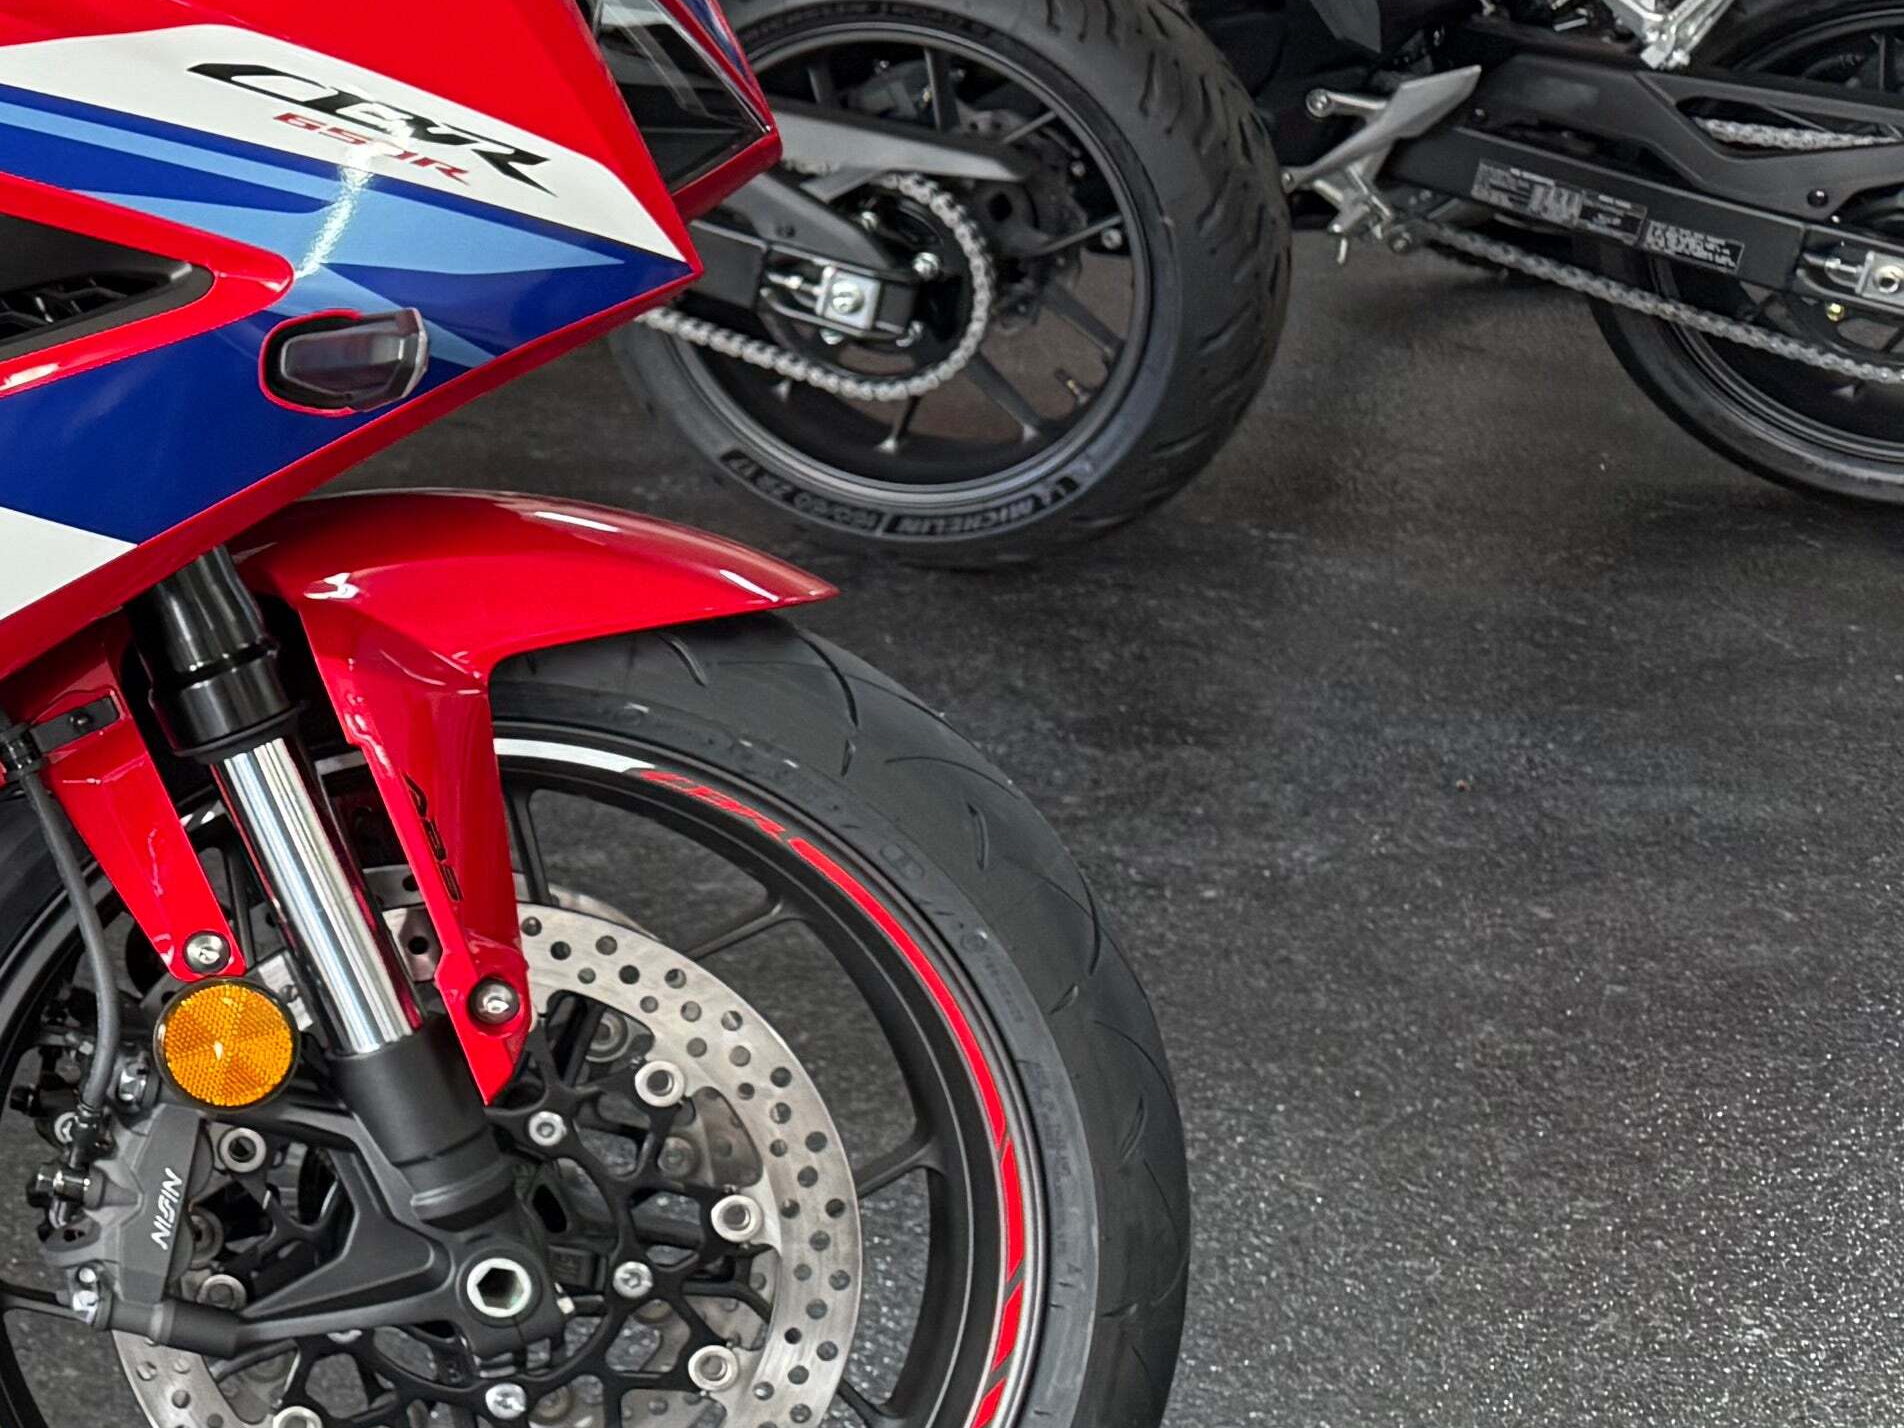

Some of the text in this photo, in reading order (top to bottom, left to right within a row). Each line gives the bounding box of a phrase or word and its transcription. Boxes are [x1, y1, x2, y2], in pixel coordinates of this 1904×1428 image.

[188, 63, 557, 197] CBR
[272, 111, 472, 186] 650R
[894, 494, 1034, 533] MICHELIN
[149, 1167, 184, 1249] NISSIN
